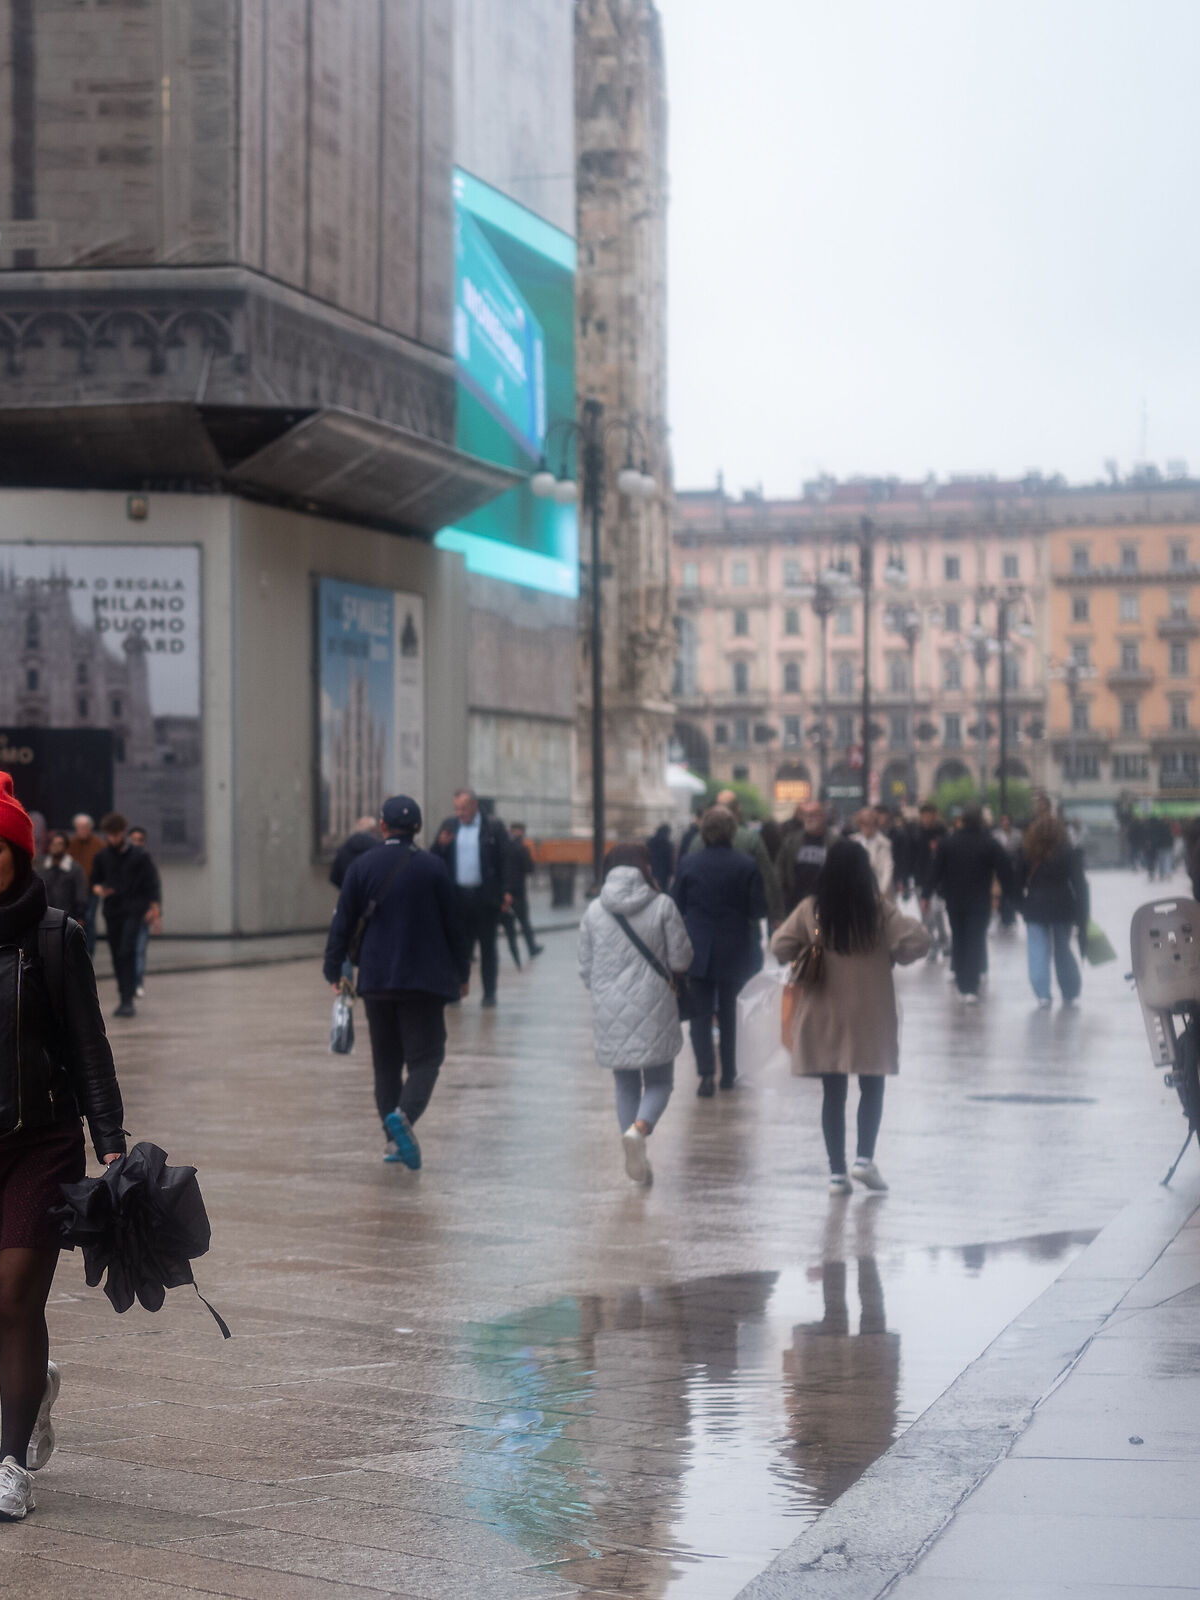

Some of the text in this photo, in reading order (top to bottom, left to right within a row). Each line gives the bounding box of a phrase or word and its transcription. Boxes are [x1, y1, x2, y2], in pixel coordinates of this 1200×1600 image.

[94, 577, 108, 591] O
[115, 577, 185, 591] REGALA
[93, 596, 185, 613] MILANO
[96, 617, 185, 633] DUOMO
[121, 638, 185, 655] CARD
